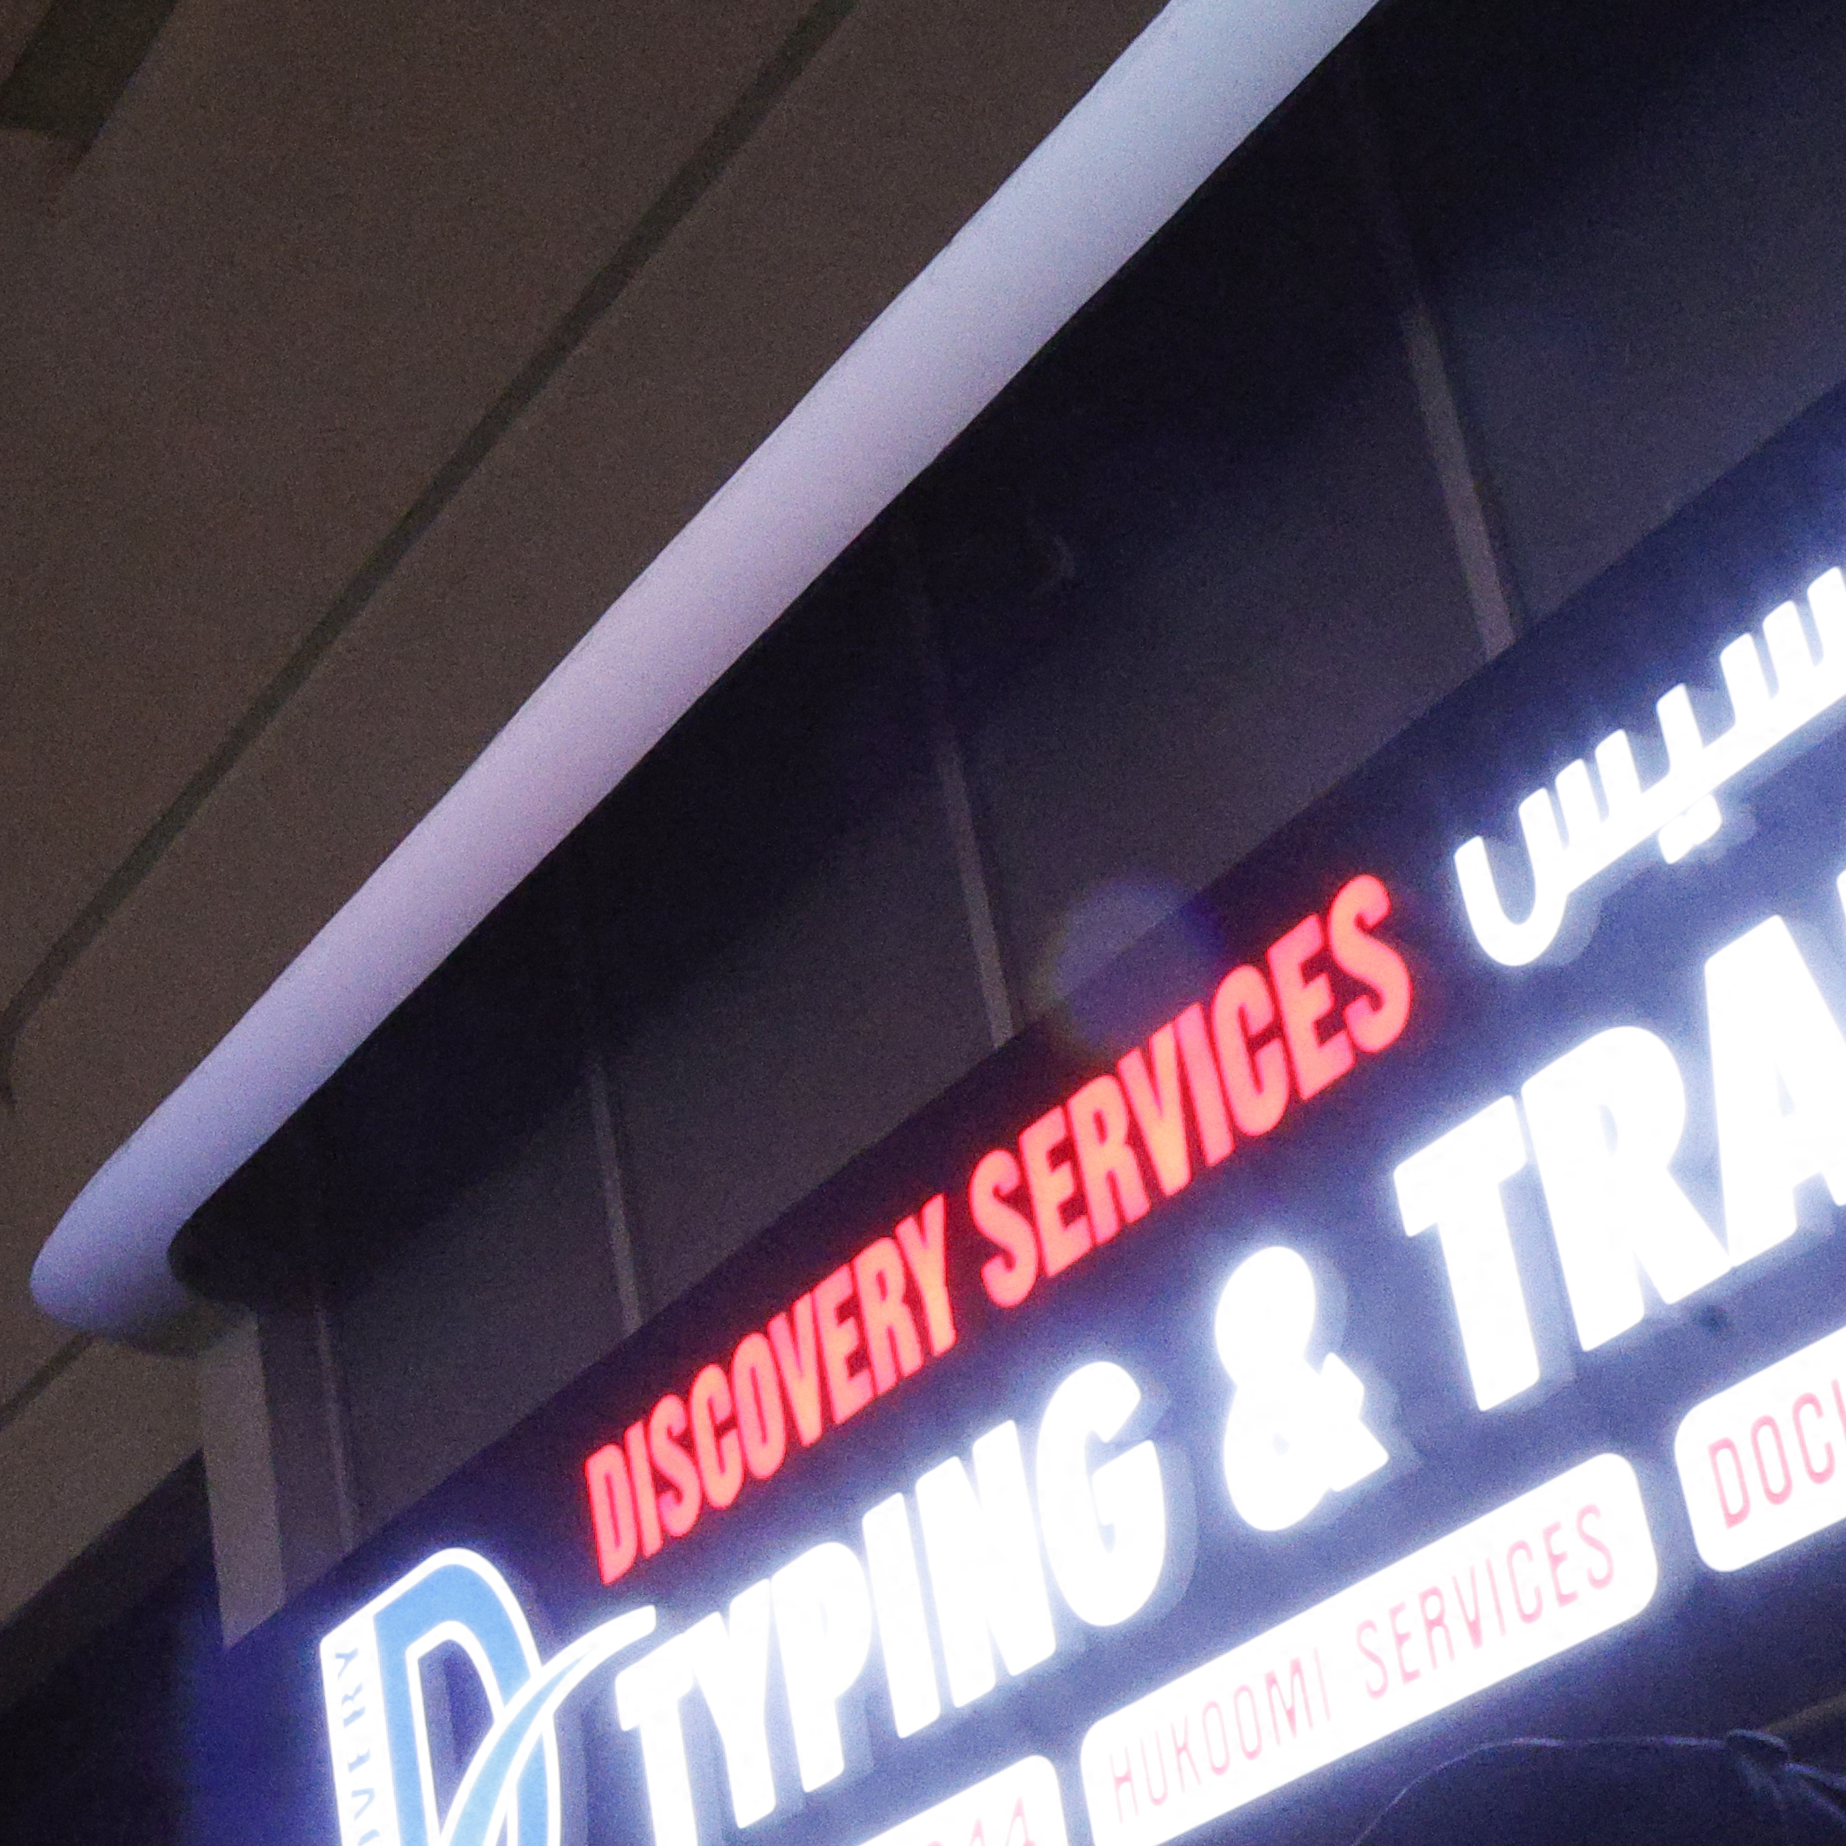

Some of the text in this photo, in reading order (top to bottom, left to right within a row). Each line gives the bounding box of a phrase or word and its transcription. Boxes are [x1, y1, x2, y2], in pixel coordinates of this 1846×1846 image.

[585, 873, 1412, 1585] DISCOVERY SERVICES
[1213, 1245, 1390, 1533] &
[1392, 866, 1846, 1412] TRA
[1109, 1502, 1615, 1825] HUKOOMI SERVICES
